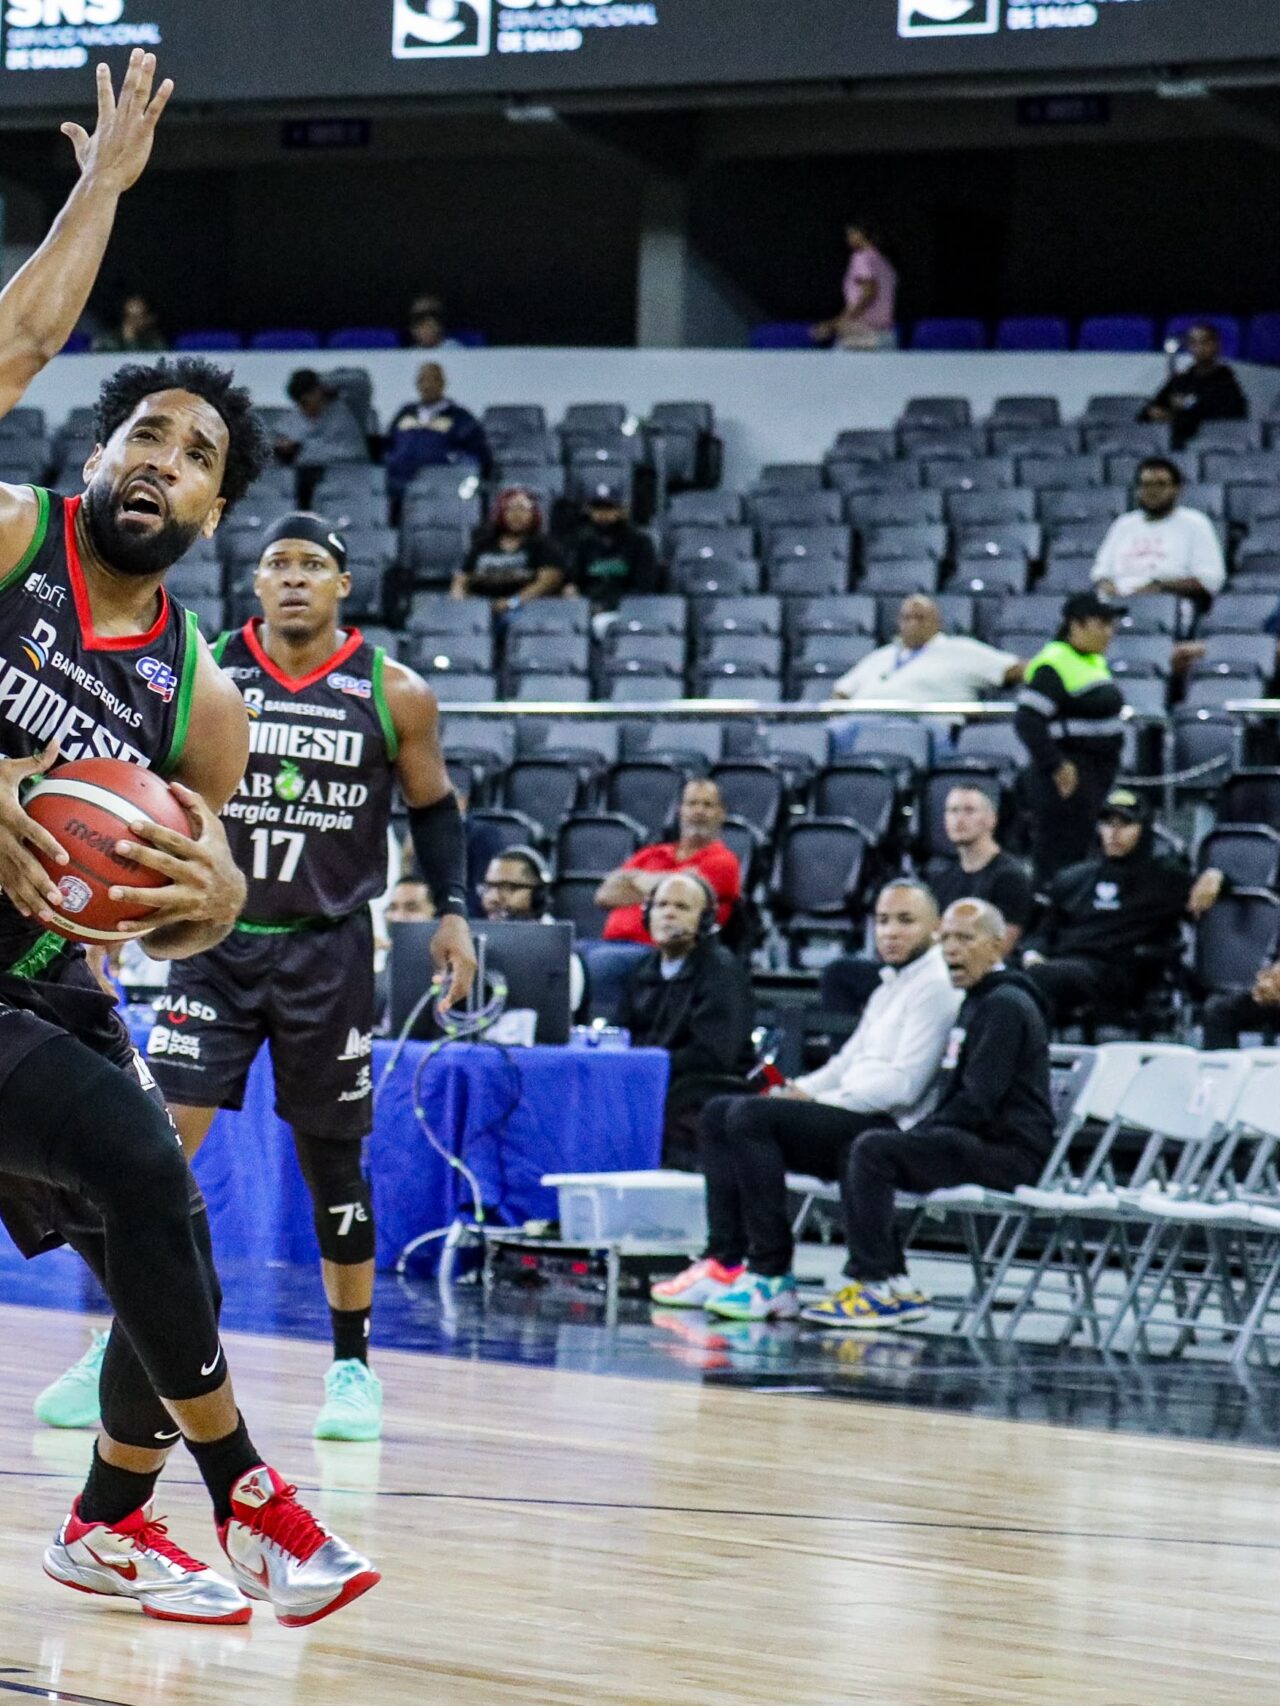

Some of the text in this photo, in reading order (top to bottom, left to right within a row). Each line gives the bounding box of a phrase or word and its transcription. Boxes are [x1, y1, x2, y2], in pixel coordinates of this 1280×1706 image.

[51, 651, 143, 728] BANRESERVAS
[283, 804, 355, 833] Limpia
[249, 827, 306, 883] 17
